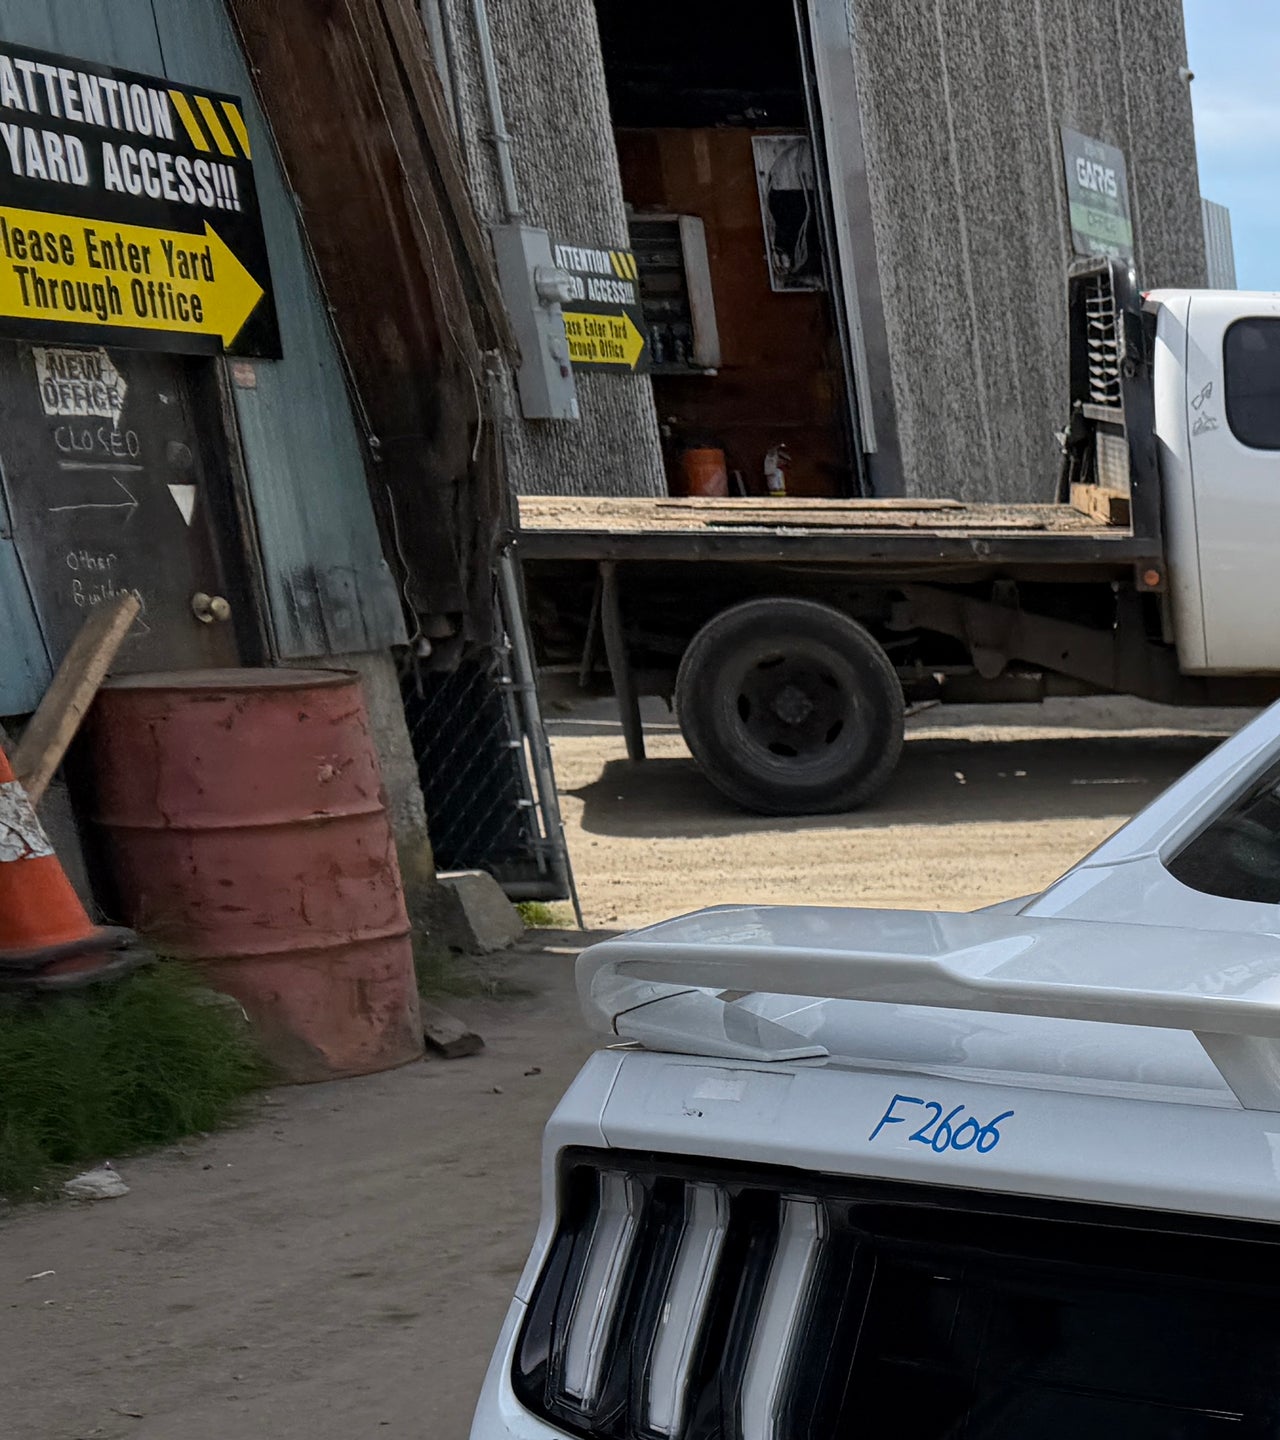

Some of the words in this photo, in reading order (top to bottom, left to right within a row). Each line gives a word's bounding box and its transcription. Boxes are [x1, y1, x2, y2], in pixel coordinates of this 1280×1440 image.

[0, 54, 175, 141] ATTENTION
[1, 122, 89, 187] YARD
[102, 142, 241, 212] ACCESS!!!
[0, 215, 75, 267] lease
[83, 228, 151, 275] Enter
[160, 238, 215, 283] Yard
[555, 244, 612, 275] ATTENTION
[13, 264, 122, 321] Through
[131, 278, 203, 323] Office
[587, 277, 636, 305] ACCESS!!!
[568, 340, 597, 360] hrough
[599, 340, 624, 359] Office
[584, 317, 606, 339] Enter
[608, 320, 628, 340] Yard
[868, 1093, 1015, 1154] F2606
